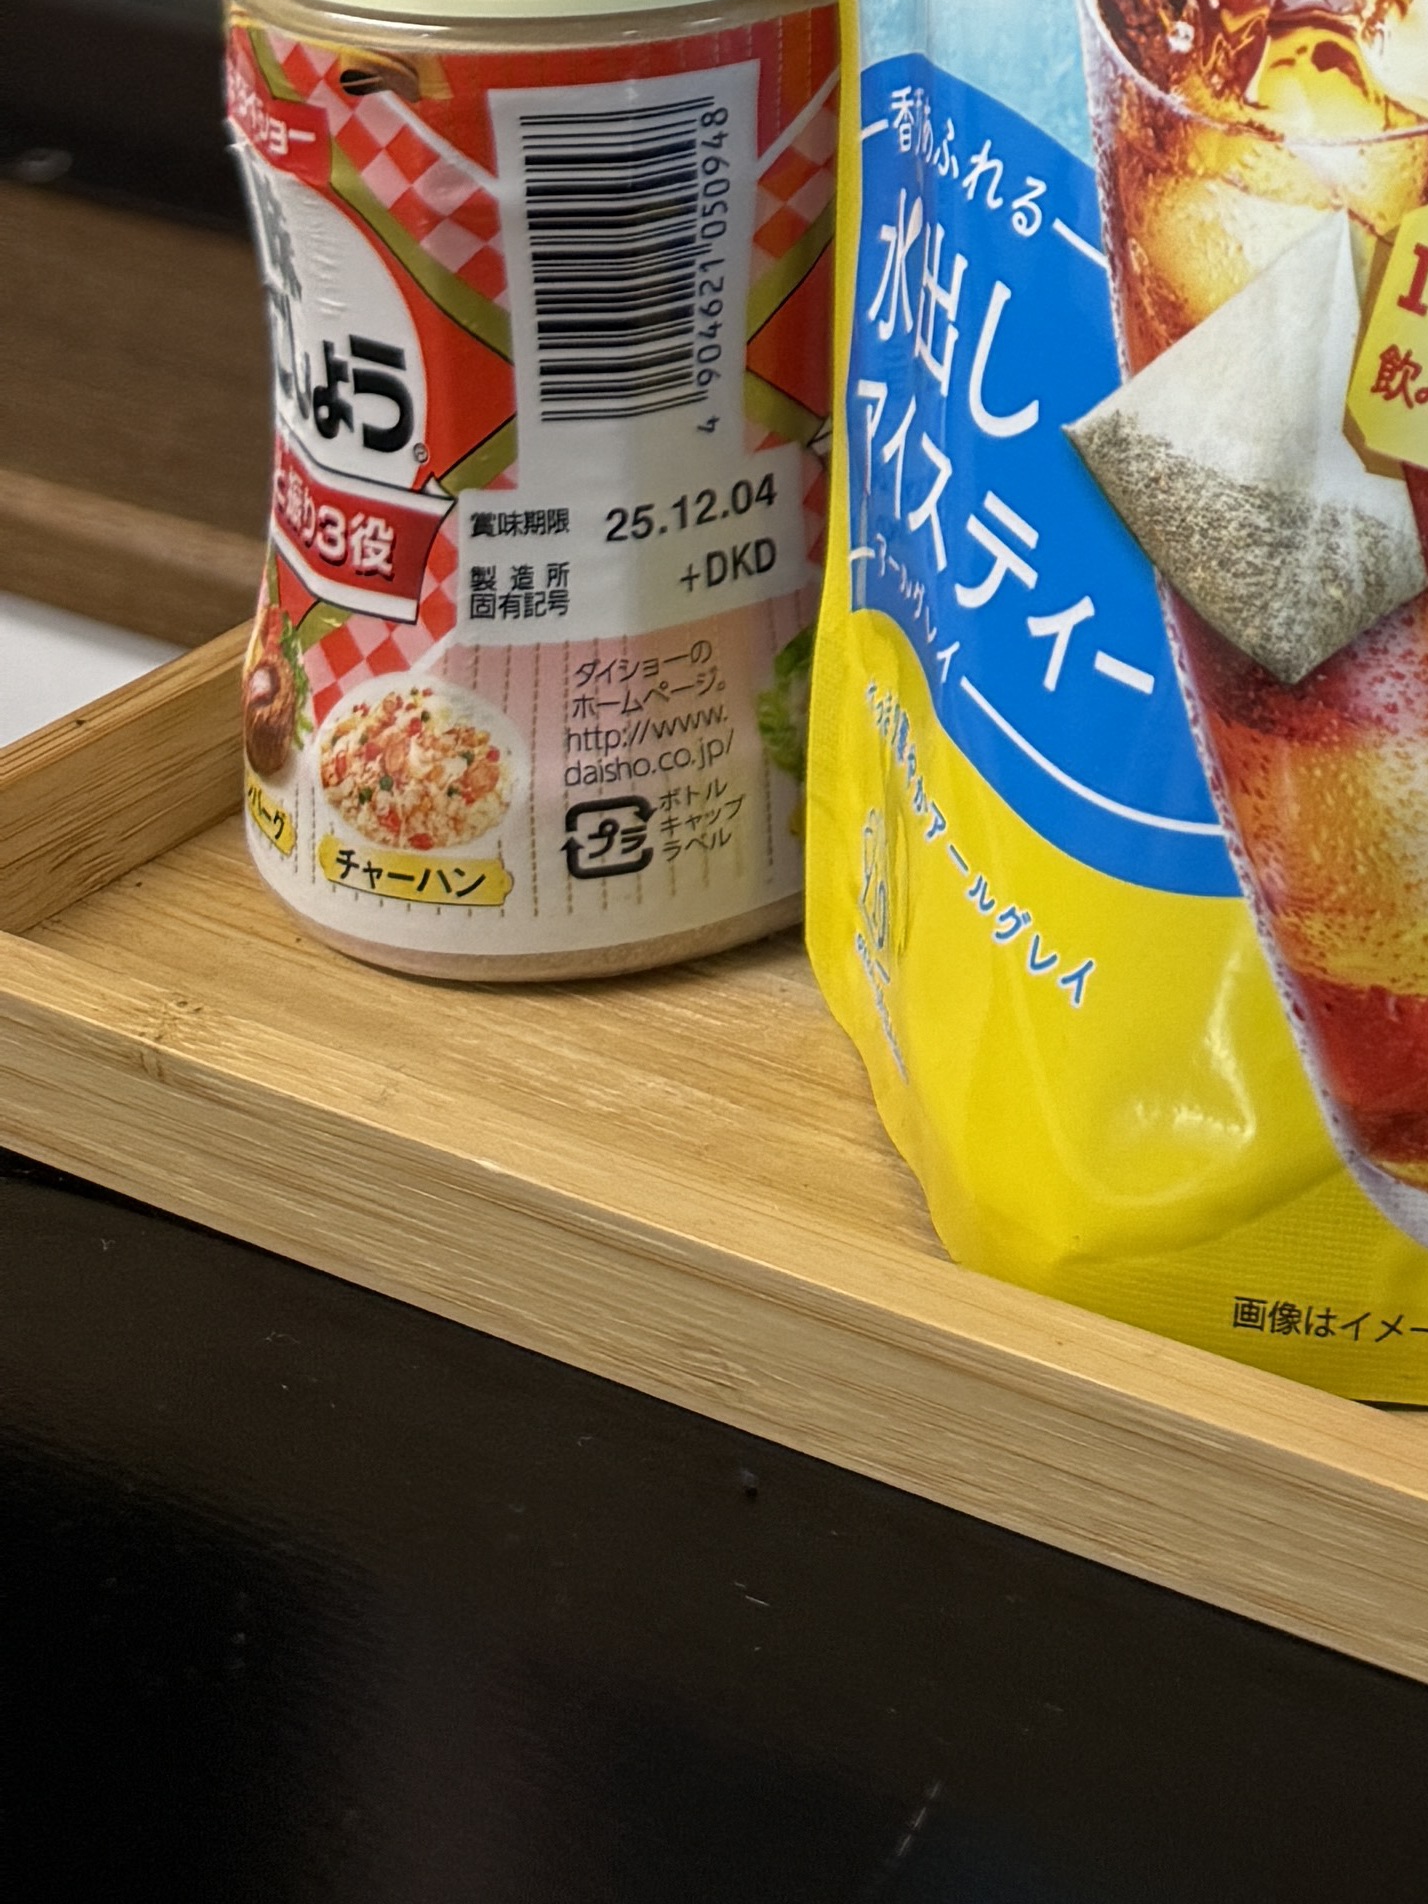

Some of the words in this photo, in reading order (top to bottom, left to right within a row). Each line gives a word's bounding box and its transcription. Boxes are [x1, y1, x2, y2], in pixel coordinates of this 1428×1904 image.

[868, 188, 1040, 439] 水出し
[469, 508, 569, 539] 賞味期限
[606, 473, 777, 543] 25.12.04
[857, 378, 1154, 697] アイスティー
[470, 562, 569, 590] 製造所
[680, 537, 777, 592] +DKD
[469, 593, 569, 620] 固有記号
[573, 640, 712, 688] ダイショーの
[567, 705, 728, 756] http://www.
[565, 728, 734, 787] daisho.co.jp/
[659, 779, 728, 811] ボトル
[660, 793, 746, 836] キャップ
[588, 818, 647, 859] プラ
[663, 830, 732, 862] ラベル
[335, 848, 487, 896] チャーハン
